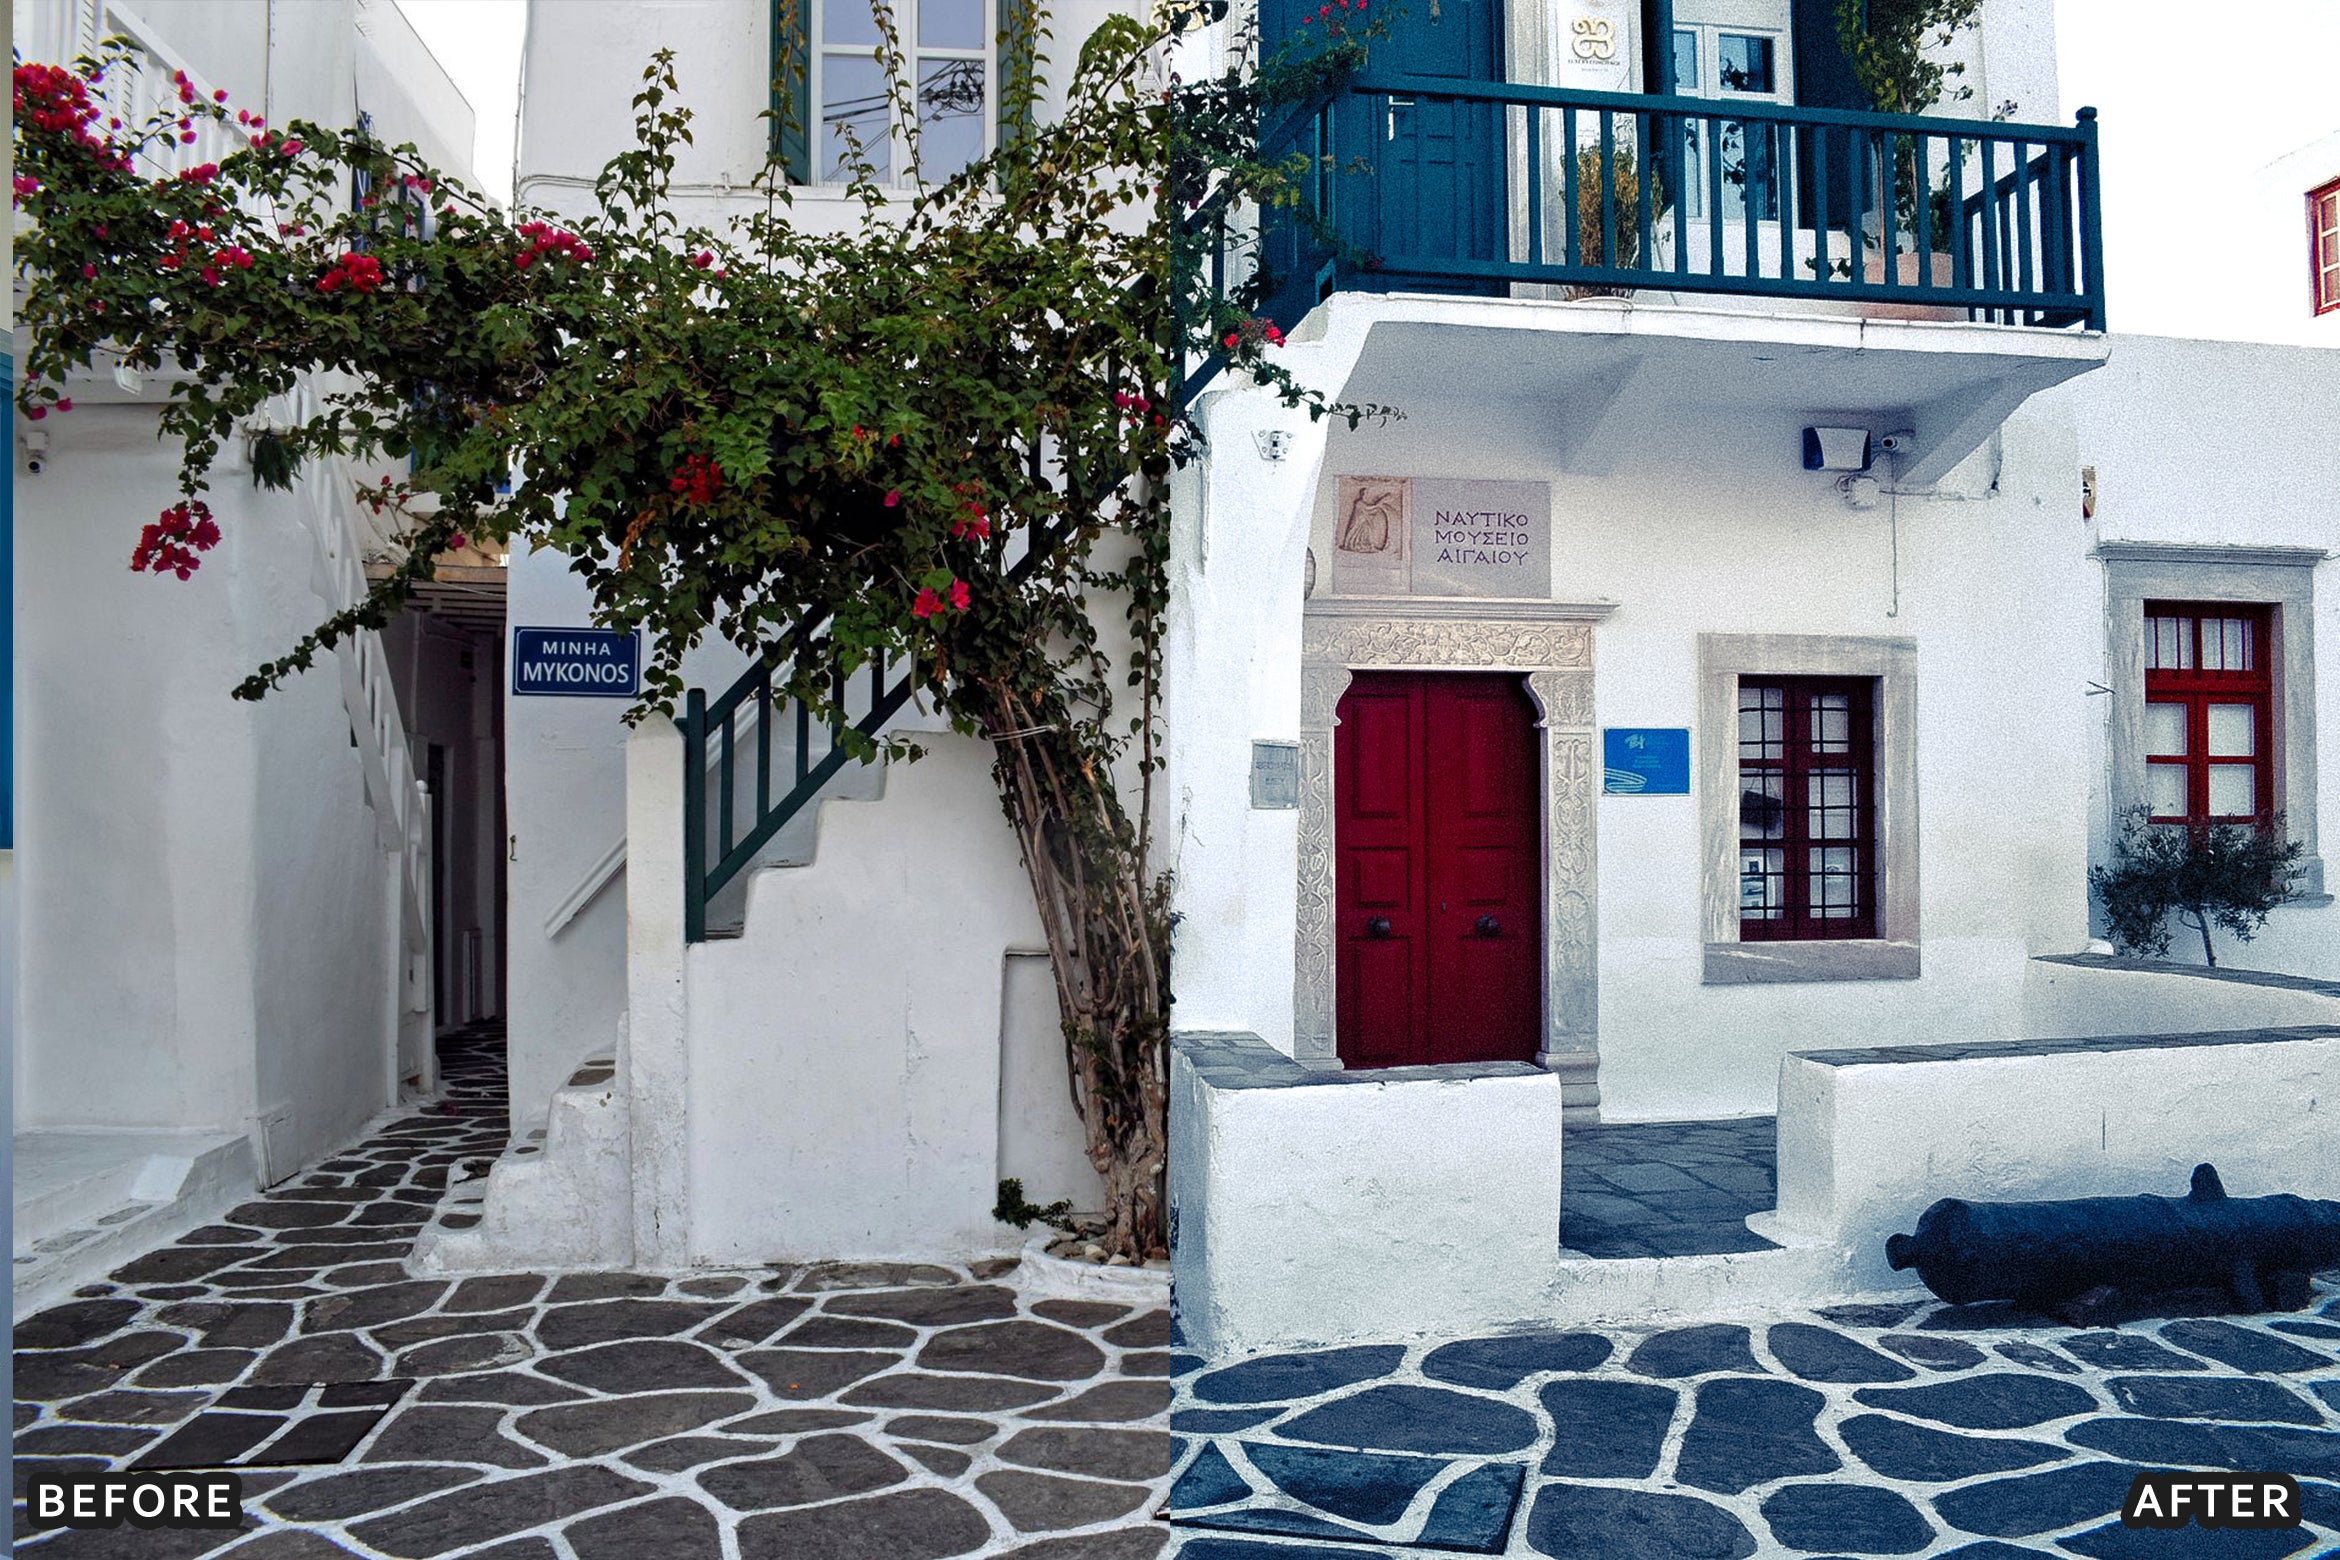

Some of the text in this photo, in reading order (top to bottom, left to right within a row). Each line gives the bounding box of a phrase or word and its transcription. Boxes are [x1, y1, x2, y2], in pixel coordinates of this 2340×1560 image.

[1434, 511, 1529, 528] ΝΑΥΤΙΚΟ
[1434, 530, 1529, 546] ΜΟΥΣΕΙΟ
[1437, 548, 1529, 566] ΑΙΓΑΙΟΥ
[542, 641, 611, 656] MINHA
[523, 661, 629, 683] MYKONOS
